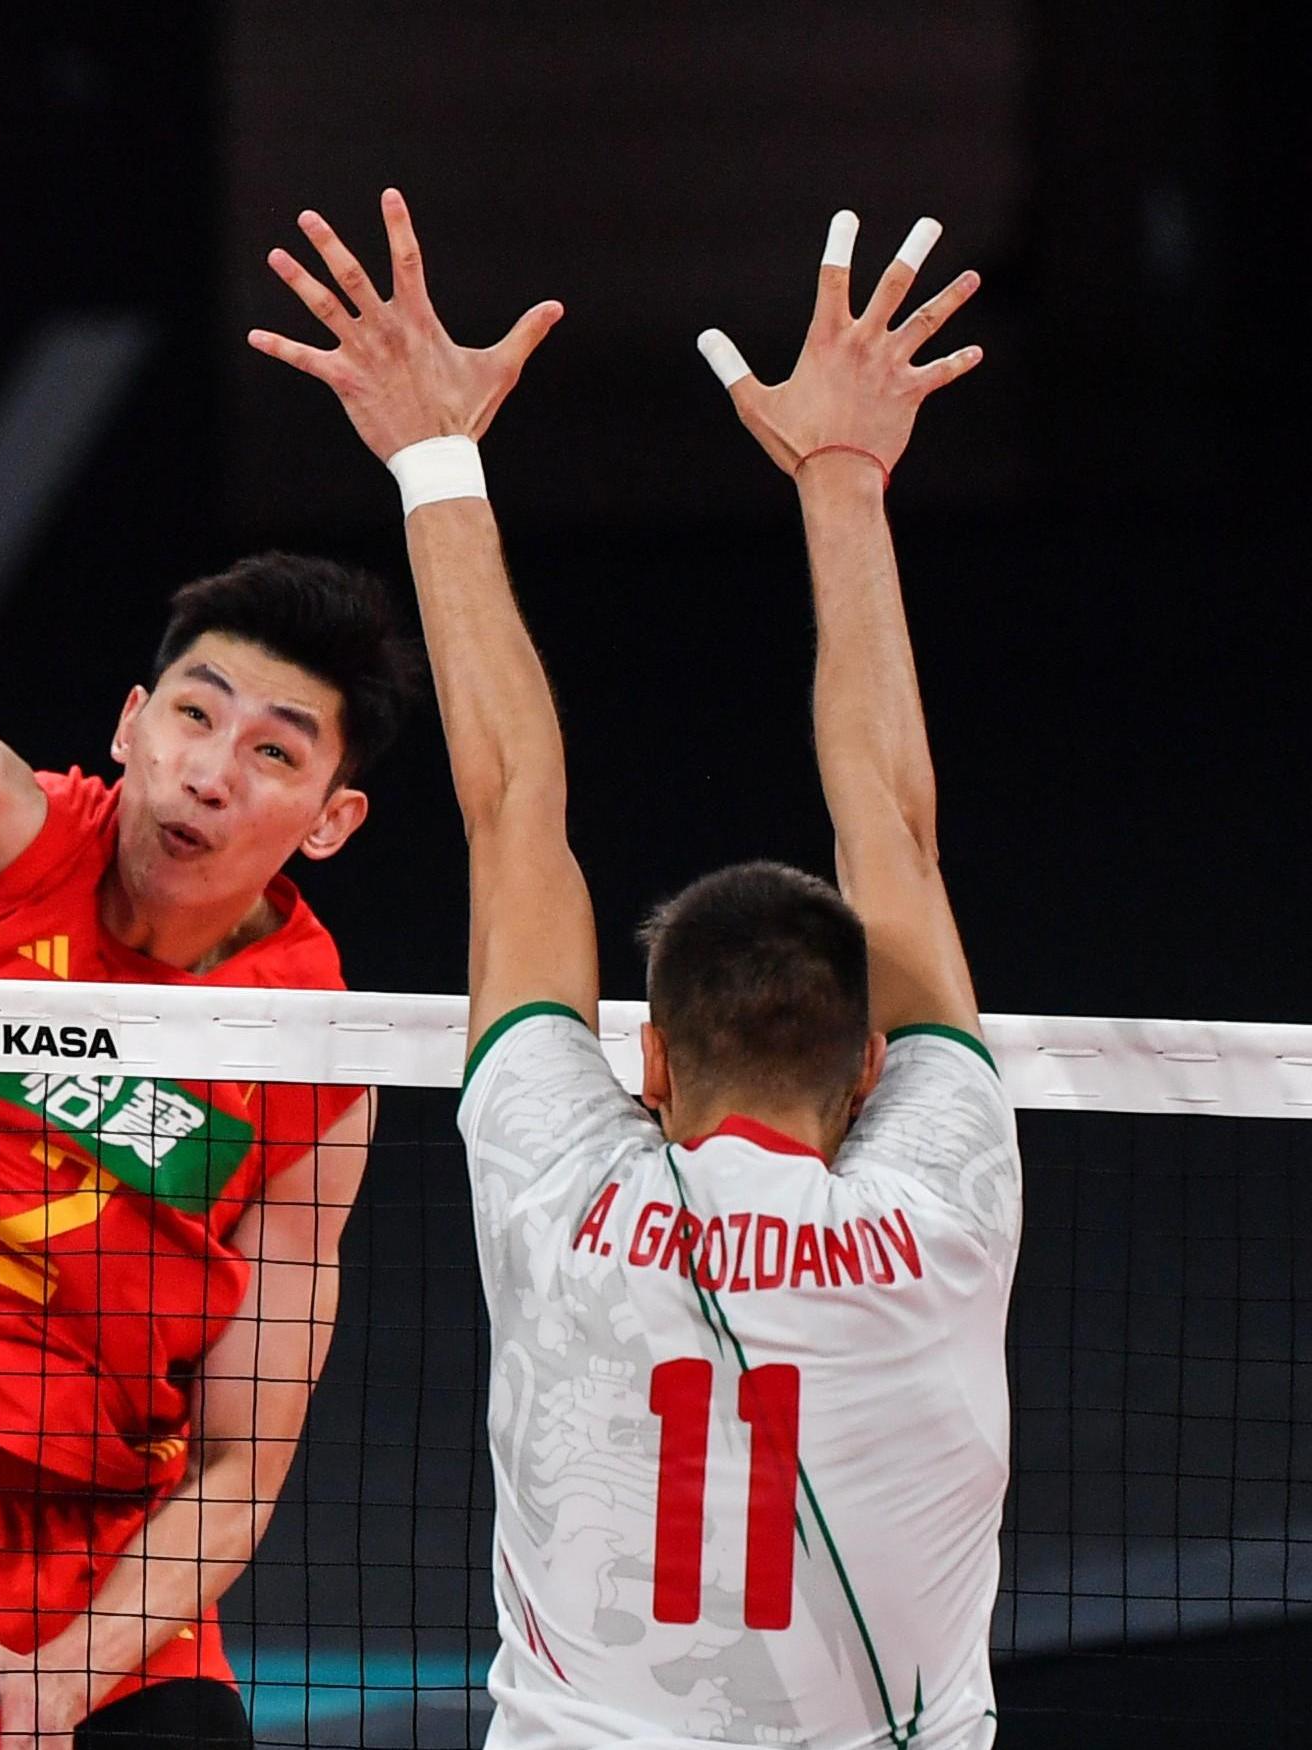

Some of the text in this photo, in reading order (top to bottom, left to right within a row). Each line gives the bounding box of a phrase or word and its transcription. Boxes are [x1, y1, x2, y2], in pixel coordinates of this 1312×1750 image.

[573, 1181, 923, 1293] A. GROZDANOV
[648, 1356, 801, 1632] 11
